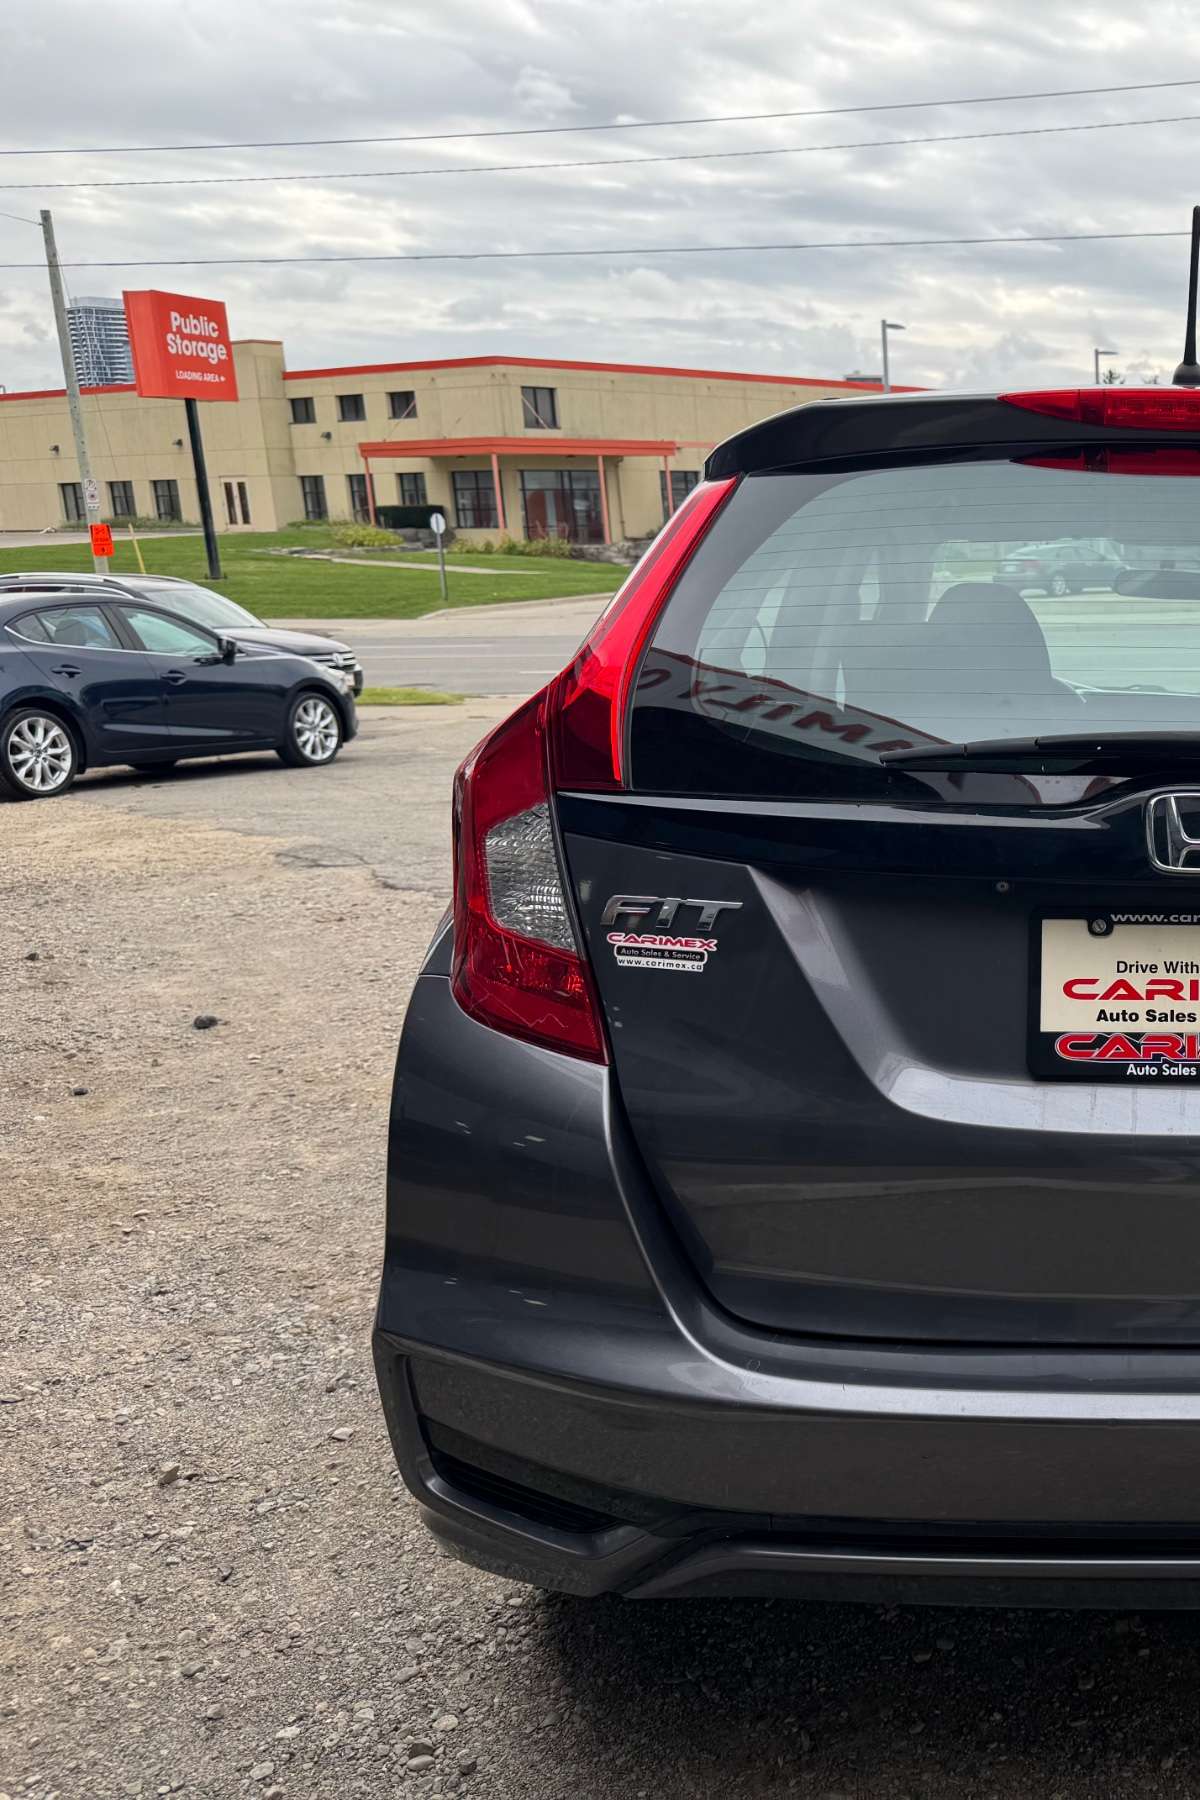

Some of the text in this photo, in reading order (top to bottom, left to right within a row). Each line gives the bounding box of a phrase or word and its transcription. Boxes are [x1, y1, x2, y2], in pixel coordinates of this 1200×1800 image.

[169, 311, 220, 338] Public
[166, 332, 228, 365] Storage
[175, 369, 220, 383] LOADING AREA
[600, 894, 744, 931] FIT
[607, 931, 718, 951] CARIMEX
[620, 947, 640, 956] Auto
[641, 948, 662, 958] Sales
[672, 951, 701, 961] Service
[618, 957, 703, 971] www.carimex.ca
[1116, 960, 1159, 974] Drive
[1163, 960, 1200, 974] With
[1096, 1009, 1140, 1023] Auto
[1145, 1009, 1197, 1023] Sales
[1126, 1063, 1158, 1076] Auto
[1162, 1063, 1197, 1076] Sales
